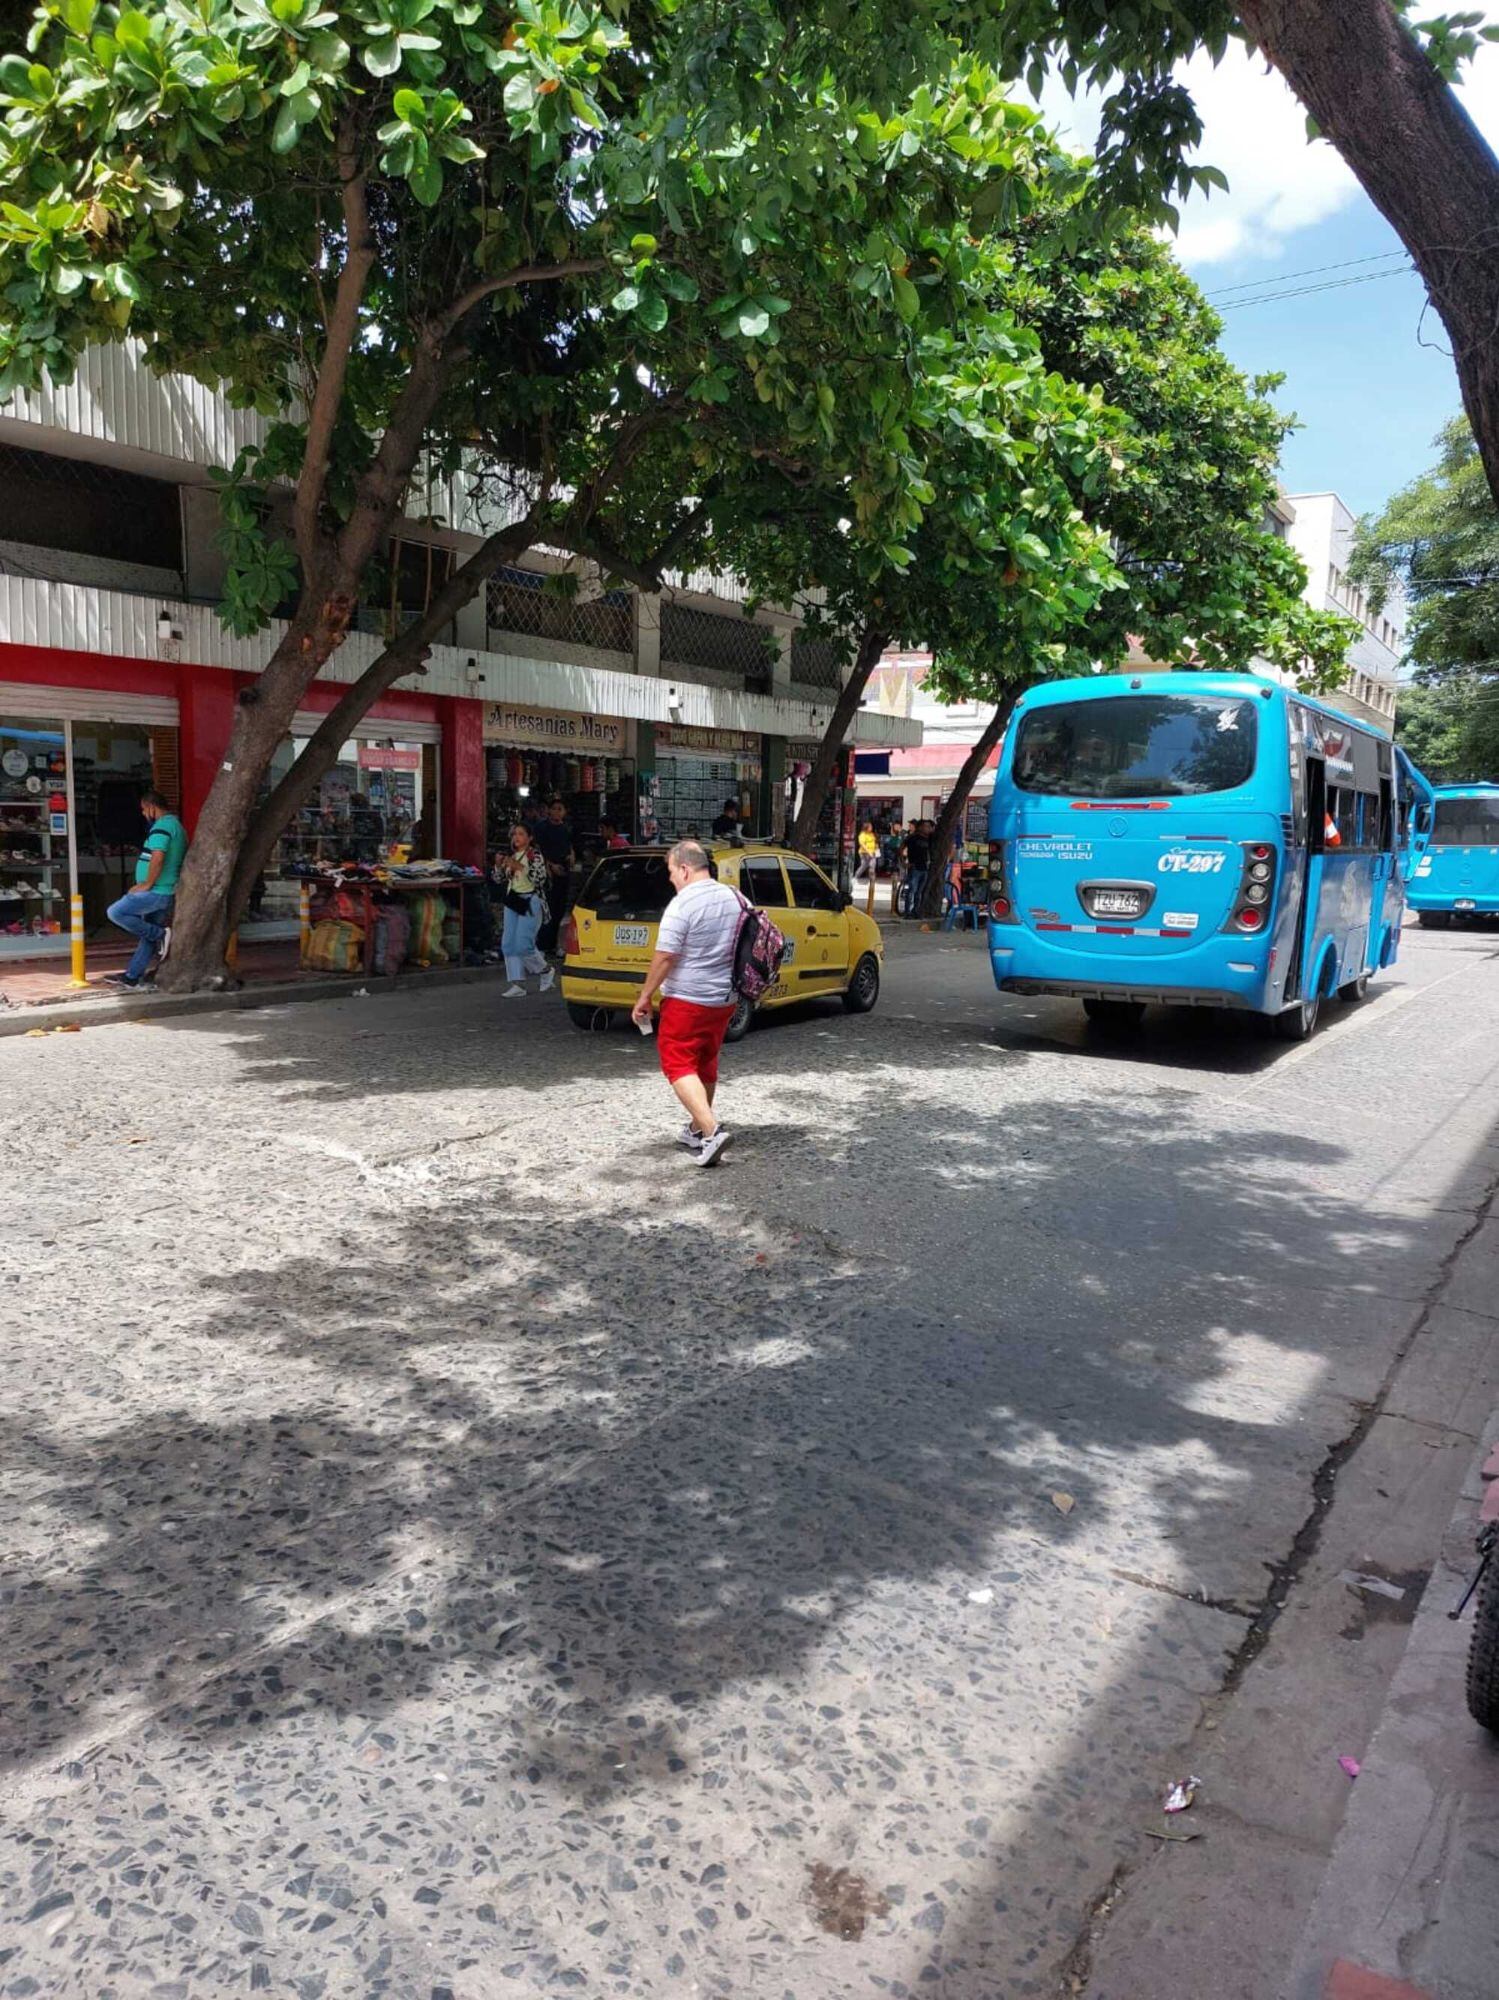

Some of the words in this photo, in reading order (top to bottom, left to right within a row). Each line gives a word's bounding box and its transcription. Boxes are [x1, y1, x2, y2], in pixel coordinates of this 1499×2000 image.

[488, 704, 576, 736] Artesanias
[580, 715, 618, 743] Mary
[1019, 842, 1092, 851] CHEVROLET
[1058, 852, 1093, 860] ISUZU
[1158, 854, 1226, 873] CT-297
[1118, 894, 1140, 908] 762
